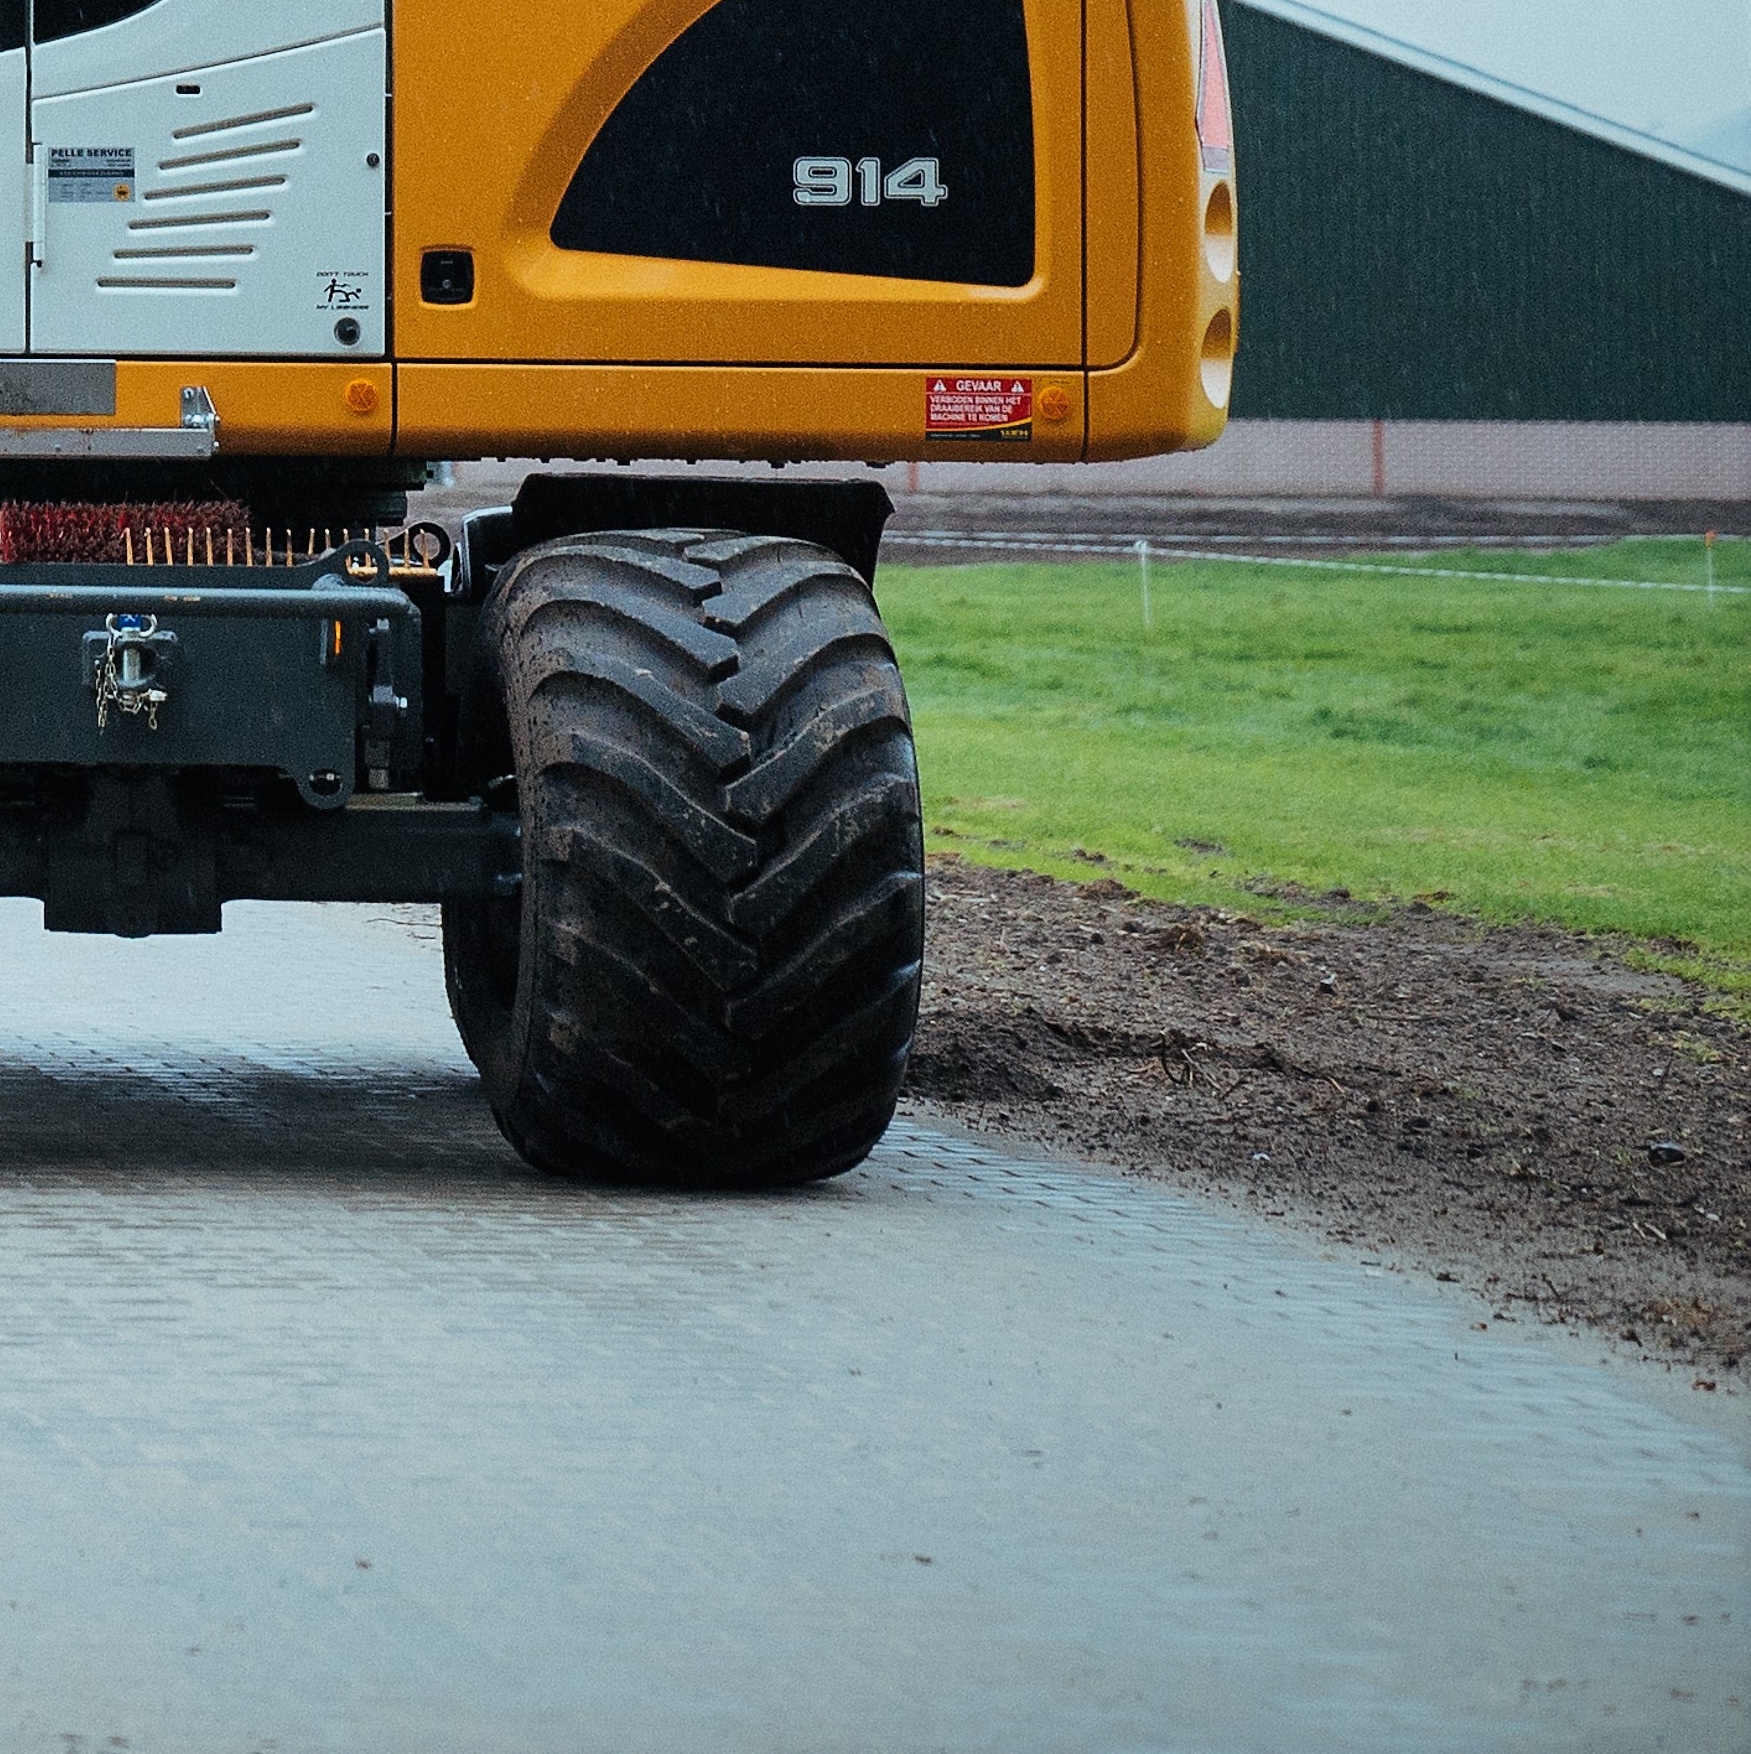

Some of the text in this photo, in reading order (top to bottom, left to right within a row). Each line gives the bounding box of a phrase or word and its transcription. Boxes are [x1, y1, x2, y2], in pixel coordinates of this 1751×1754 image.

[51, 148, 132, 157] PELLE SERVICE
[793, 157, 948, 206] 914
[956, 379, 1002, 392] GEVAAR
[929, 395, 1021, 405] VERBODEN BINNEN HET
[984, 405, 1001, 414] VAN
[1002, 404, 1013, 414] DE
[930, 413, 1008, 422] MACHINE TE KOMEN
